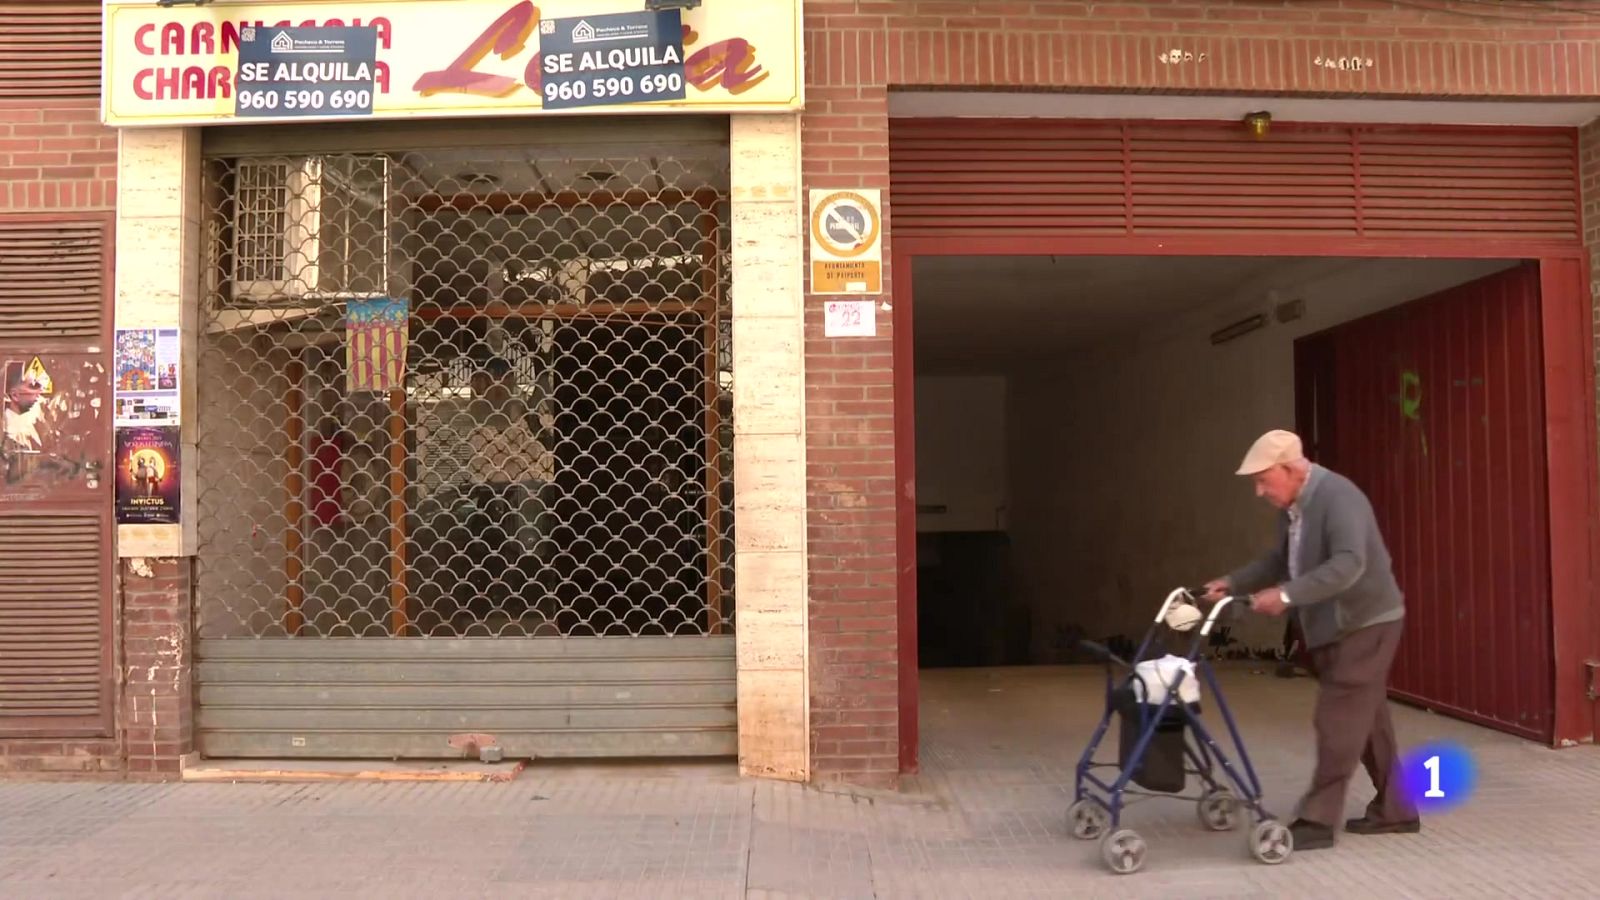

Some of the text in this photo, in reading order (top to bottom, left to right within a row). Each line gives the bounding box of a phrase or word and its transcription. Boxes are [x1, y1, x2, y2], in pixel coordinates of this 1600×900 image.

[134, 17, 391, 55] CARNA
[241, 62, 371, 83] SE ALQUILA
[544, 45, 680, 73] SE ALQUILA
[239, 89, 370, 109] 960 590 690
[545, 73, 681, 101] 960 590 690
